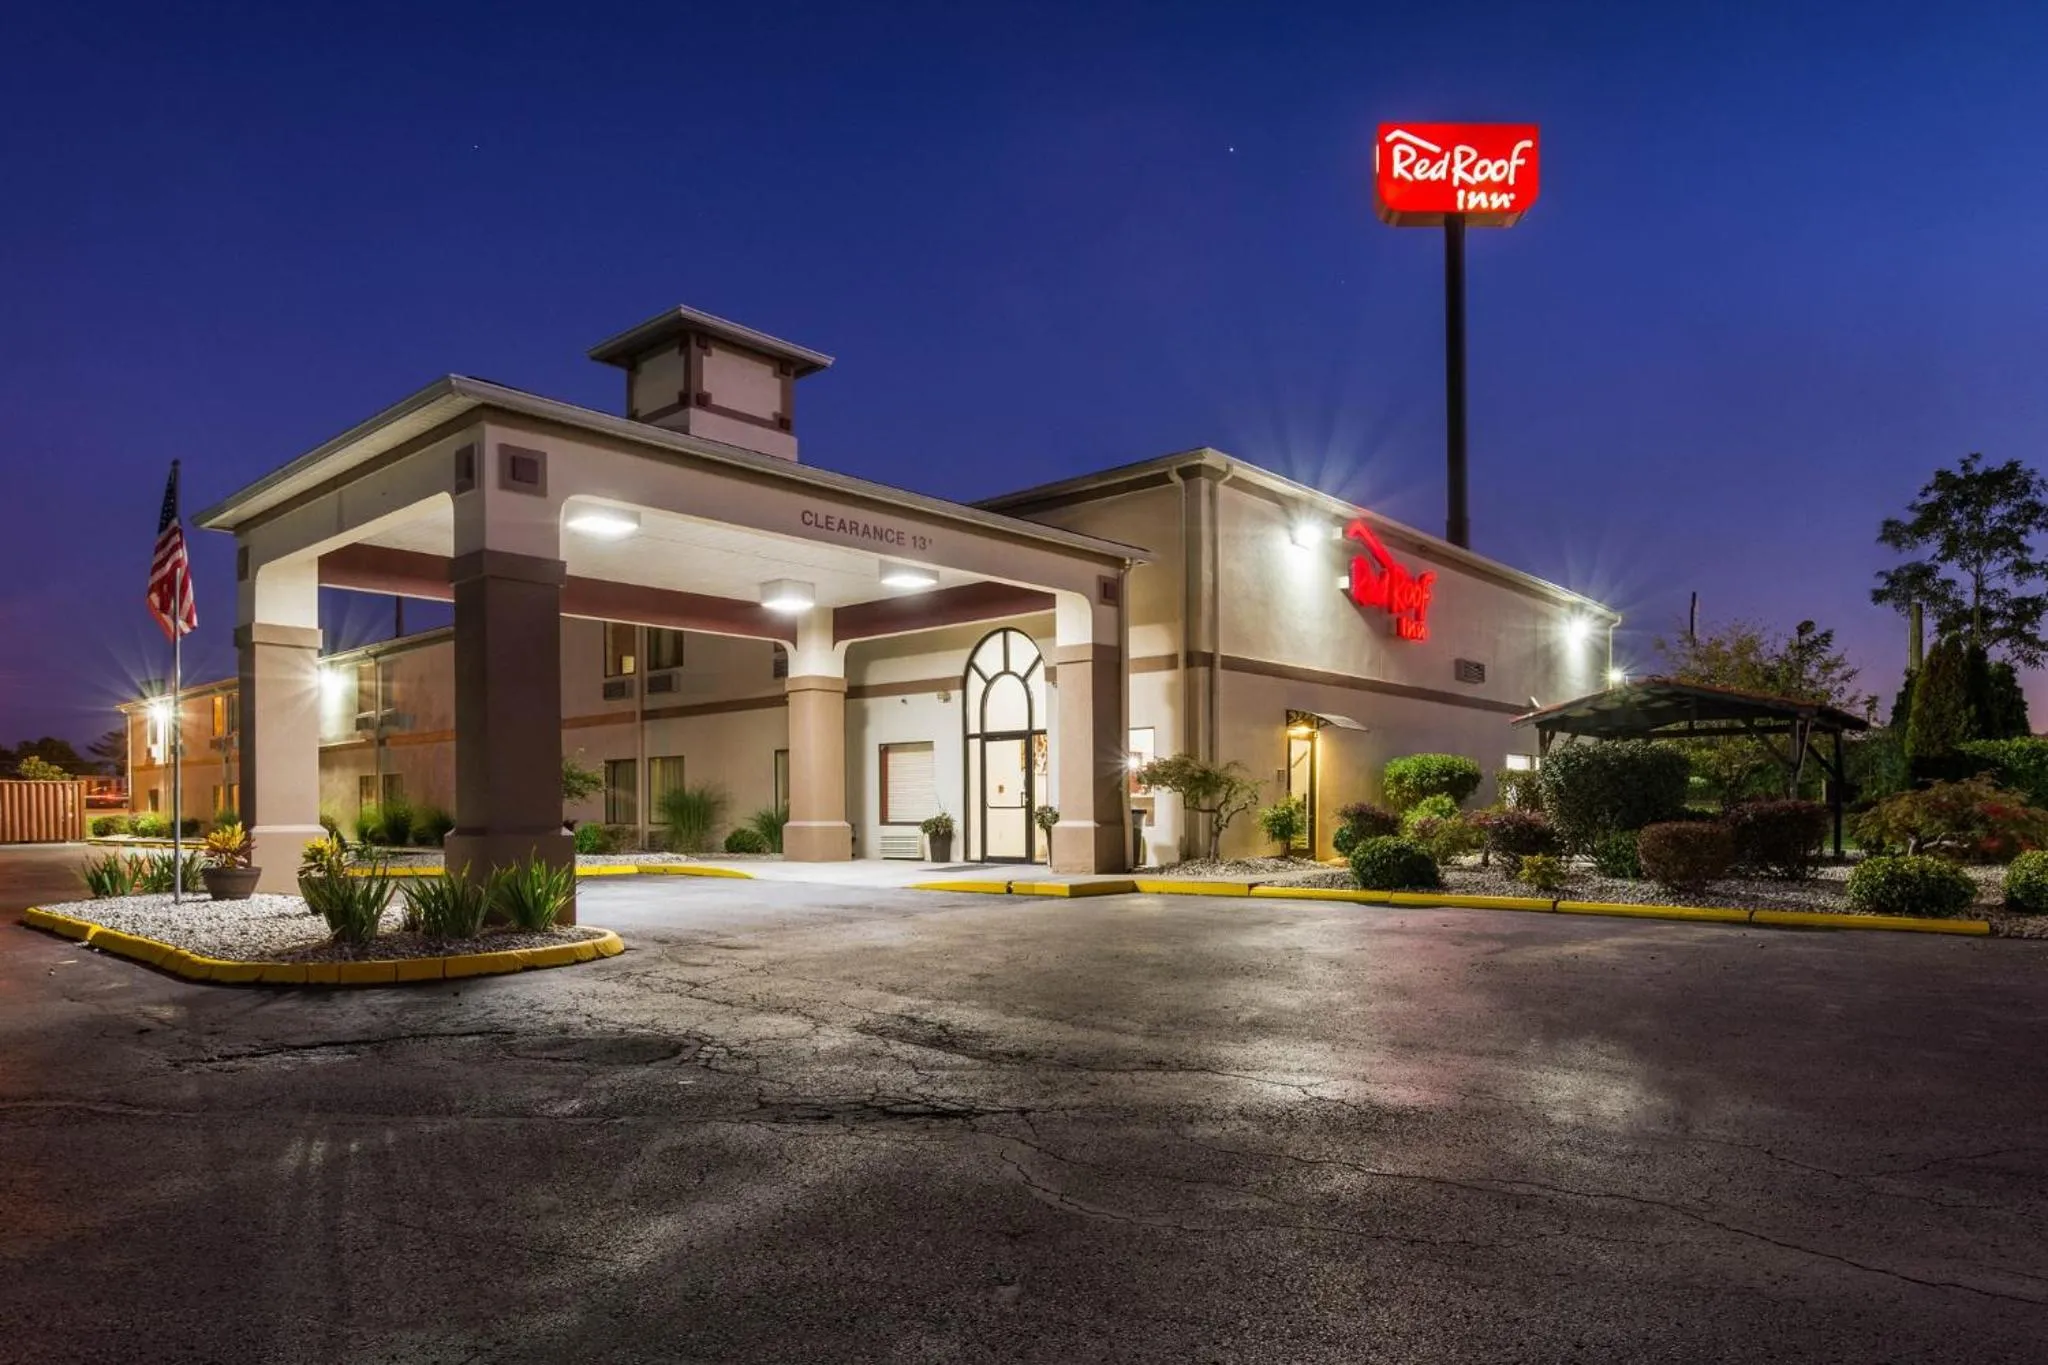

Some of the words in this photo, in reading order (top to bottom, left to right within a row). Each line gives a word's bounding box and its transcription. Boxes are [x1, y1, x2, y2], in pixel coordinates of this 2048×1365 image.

[1393, 143, 1450, 181] Red
[1452, 140, 1533, 187] Roof
[1457, 189, 1515, 210] Inn
[801, 510, 905, 546] CLEARANCE
[1389, 563, 1436, 621] Roof
